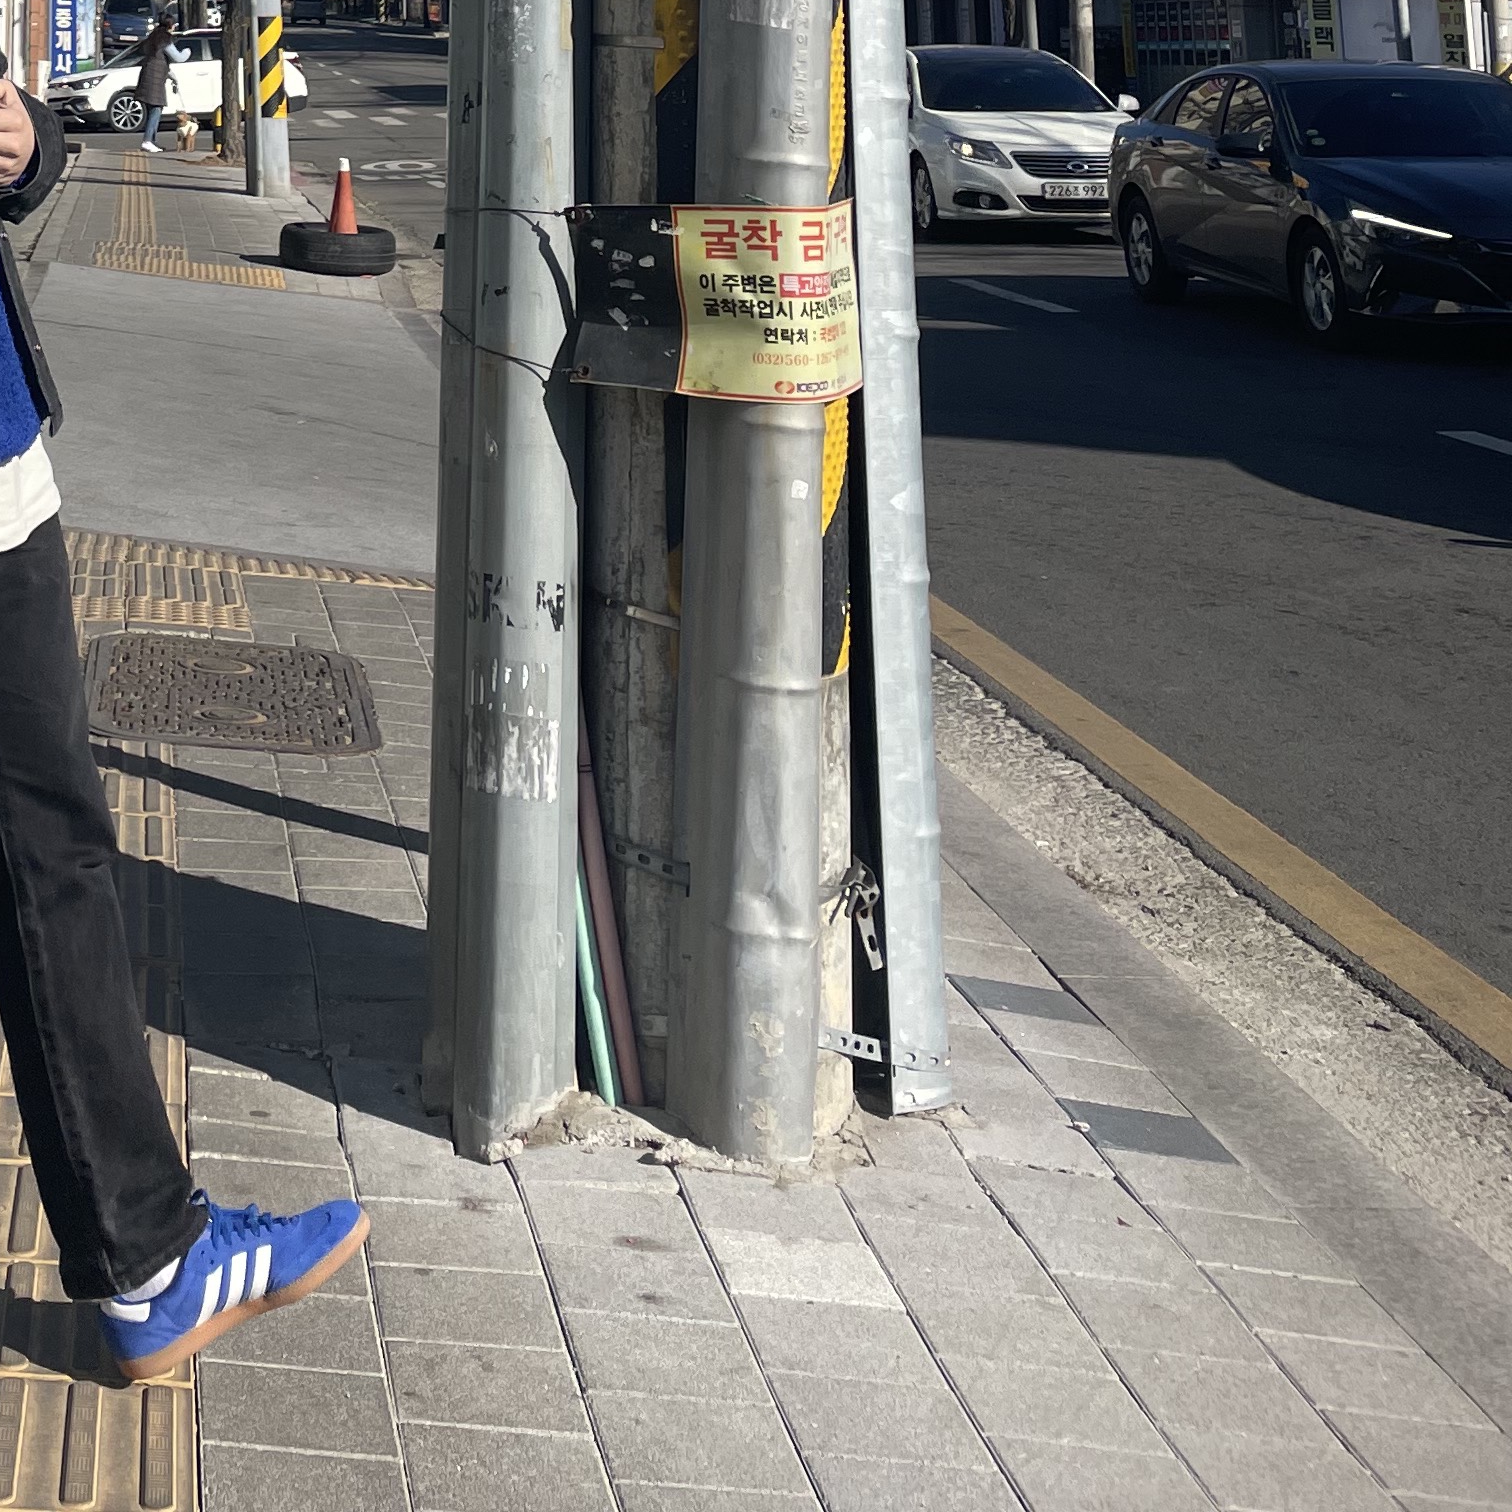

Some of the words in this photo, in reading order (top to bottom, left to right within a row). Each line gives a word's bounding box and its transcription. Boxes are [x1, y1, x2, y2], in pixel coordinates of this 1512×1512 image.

[699, 218, 783, 262] 굴착
[699, 273, 717, 292] 이
[721, 273, 777, 294] 주변은
[702, 298, 794, 320] 굴착작업시
[763, 327, 809, 345] 연락처
